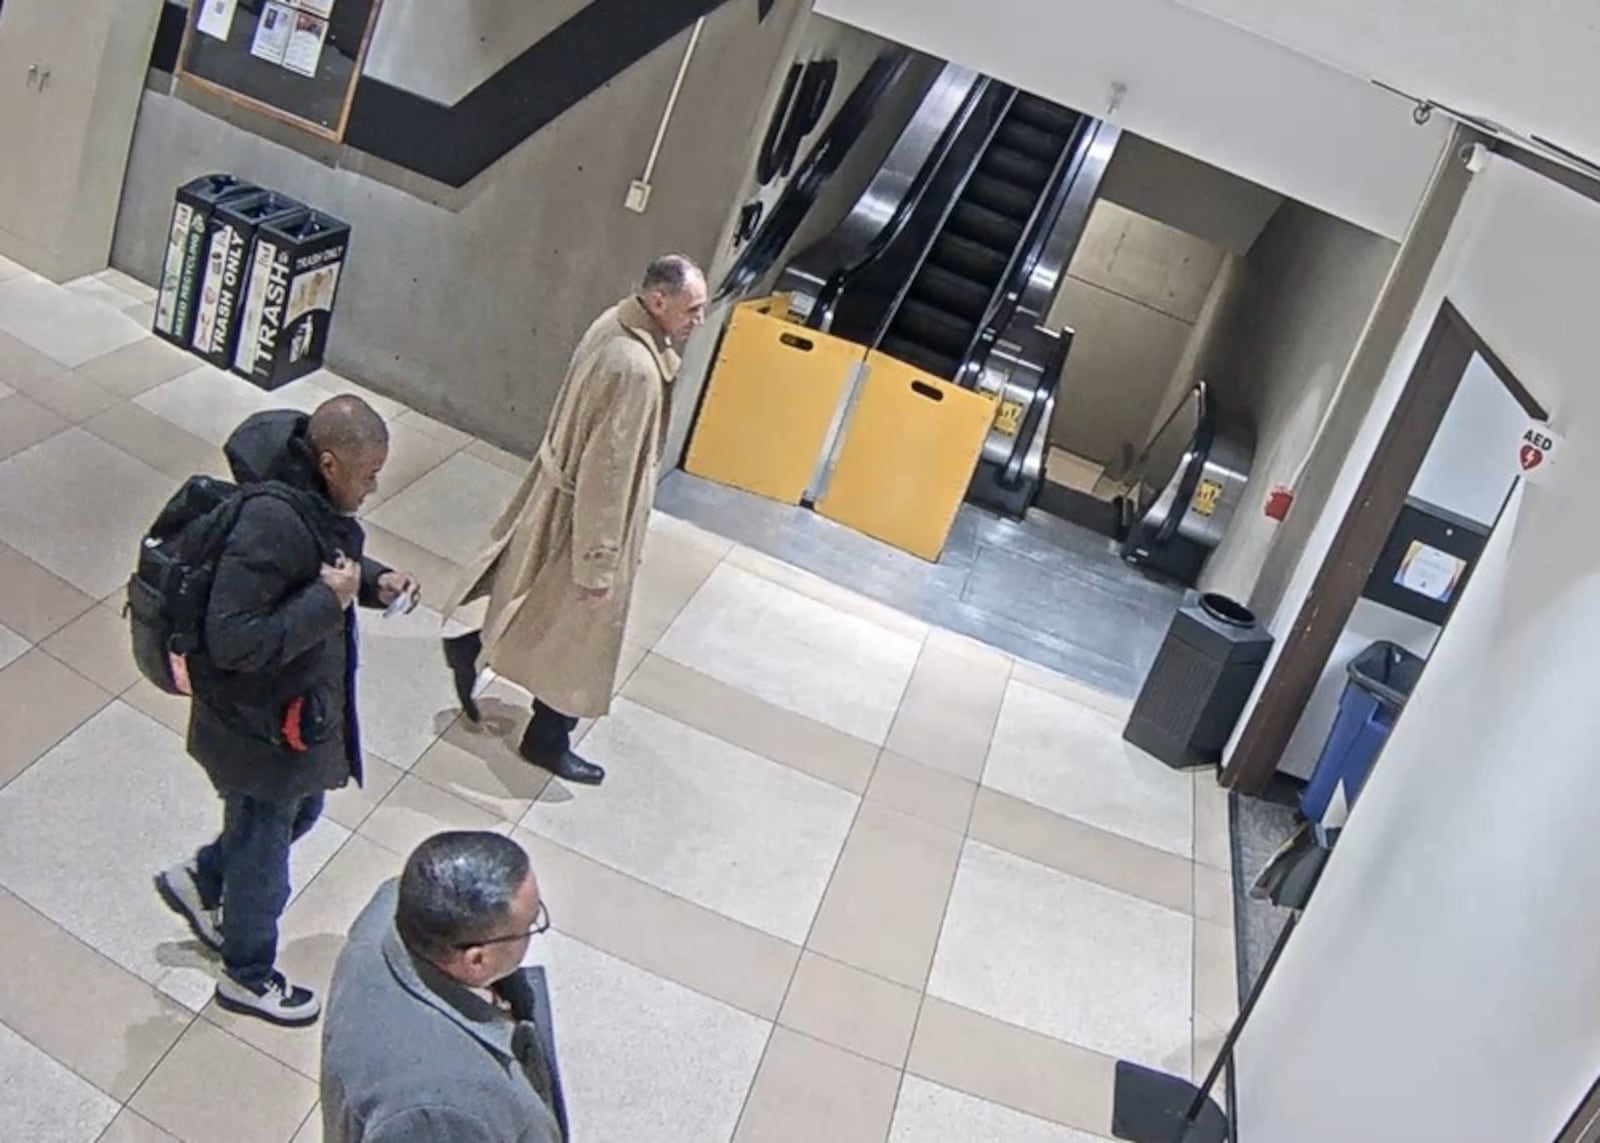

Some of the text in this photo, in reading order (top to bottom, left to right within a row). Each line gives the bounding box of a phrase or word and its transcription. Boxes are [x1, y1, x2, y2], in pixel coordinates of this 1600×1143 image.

[211, 231, 244, 353] TRASH ONLY
[255, 262, 289, 361] TRASH
[1523, 429, 1552, 451] AED
